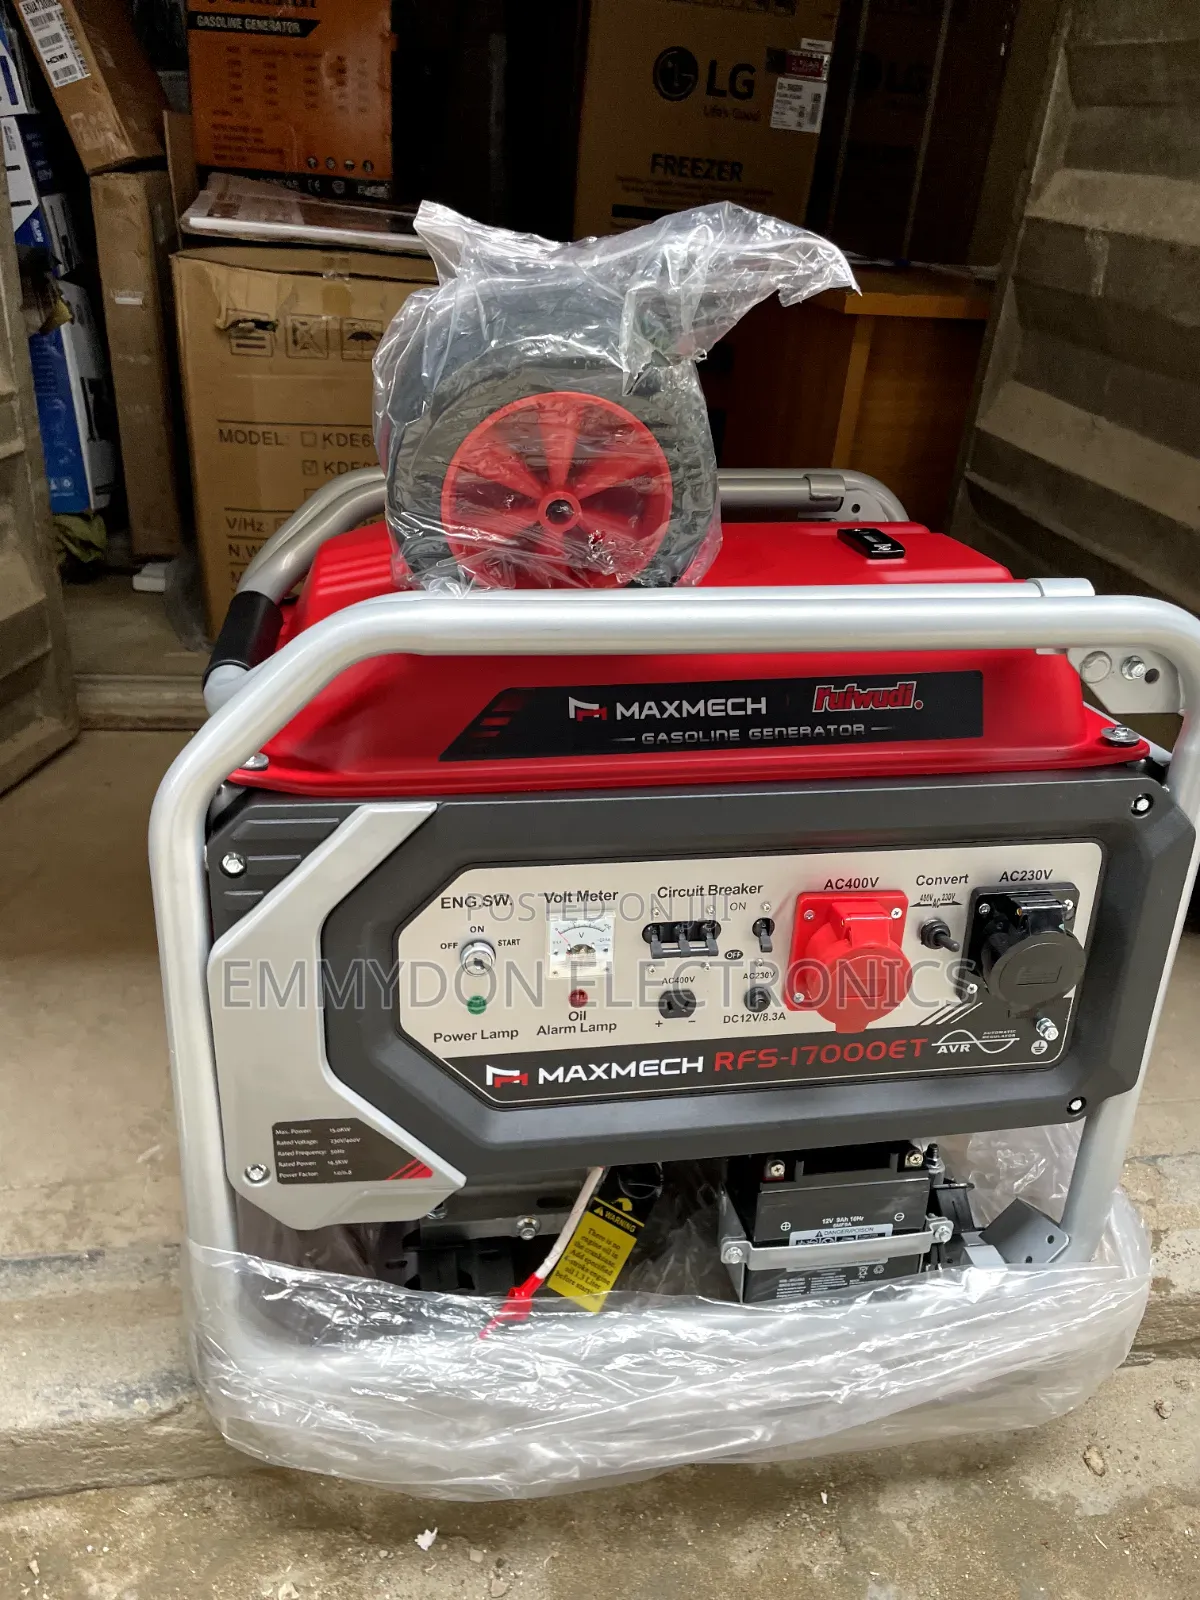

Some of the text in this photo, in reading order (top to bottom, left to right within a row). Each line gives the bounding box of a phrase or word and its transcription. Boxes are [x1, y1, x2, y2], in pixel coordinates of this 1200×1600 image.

[196, 14, 301, 34] GASOLINE GENERATOR
[707, 60, 757, 100] LG
[651, 153, 743, 182] FREEZER
[616, 697, 767, 720] MAXMECH
[641, 724, 865, 745] GASOLINE GENERATOR
[916, 874, 970, 886] Convert
[999, 869, 1054, 883] AC230V
[824, 877, 880, 890] AC400V
[544, 890, 619, 904] Volt Meter
[657, 883, 764, 899] Circuit Breaker
[441, 895, 513, 910] ENG.SW.
[729, 902, 747, 911] ON
[440, 939, 521, 950] OFF START
[726, 951, 742, 959] OFF
[661, 972, 776, 985] AC400V AC230V
[568, 1011, 587, 1021] Oil
[723, 1012, 787, 1024] DC12V/8.3A
[433, 1028, 519, 1043] Power Lamp
[537, 1022, 618, 1036] Alarm Lamp
[937, 1043, 970, 1054] AVR
[538, 1038, 928, 1085] MAXMECH RFS-17000ET
[604, 1211, 637, 1232] WARNING
[587, 1228, 606, 1241] There
[571, 1249, 585, 1260] Add
[555, 1271, 576, 1285] before
